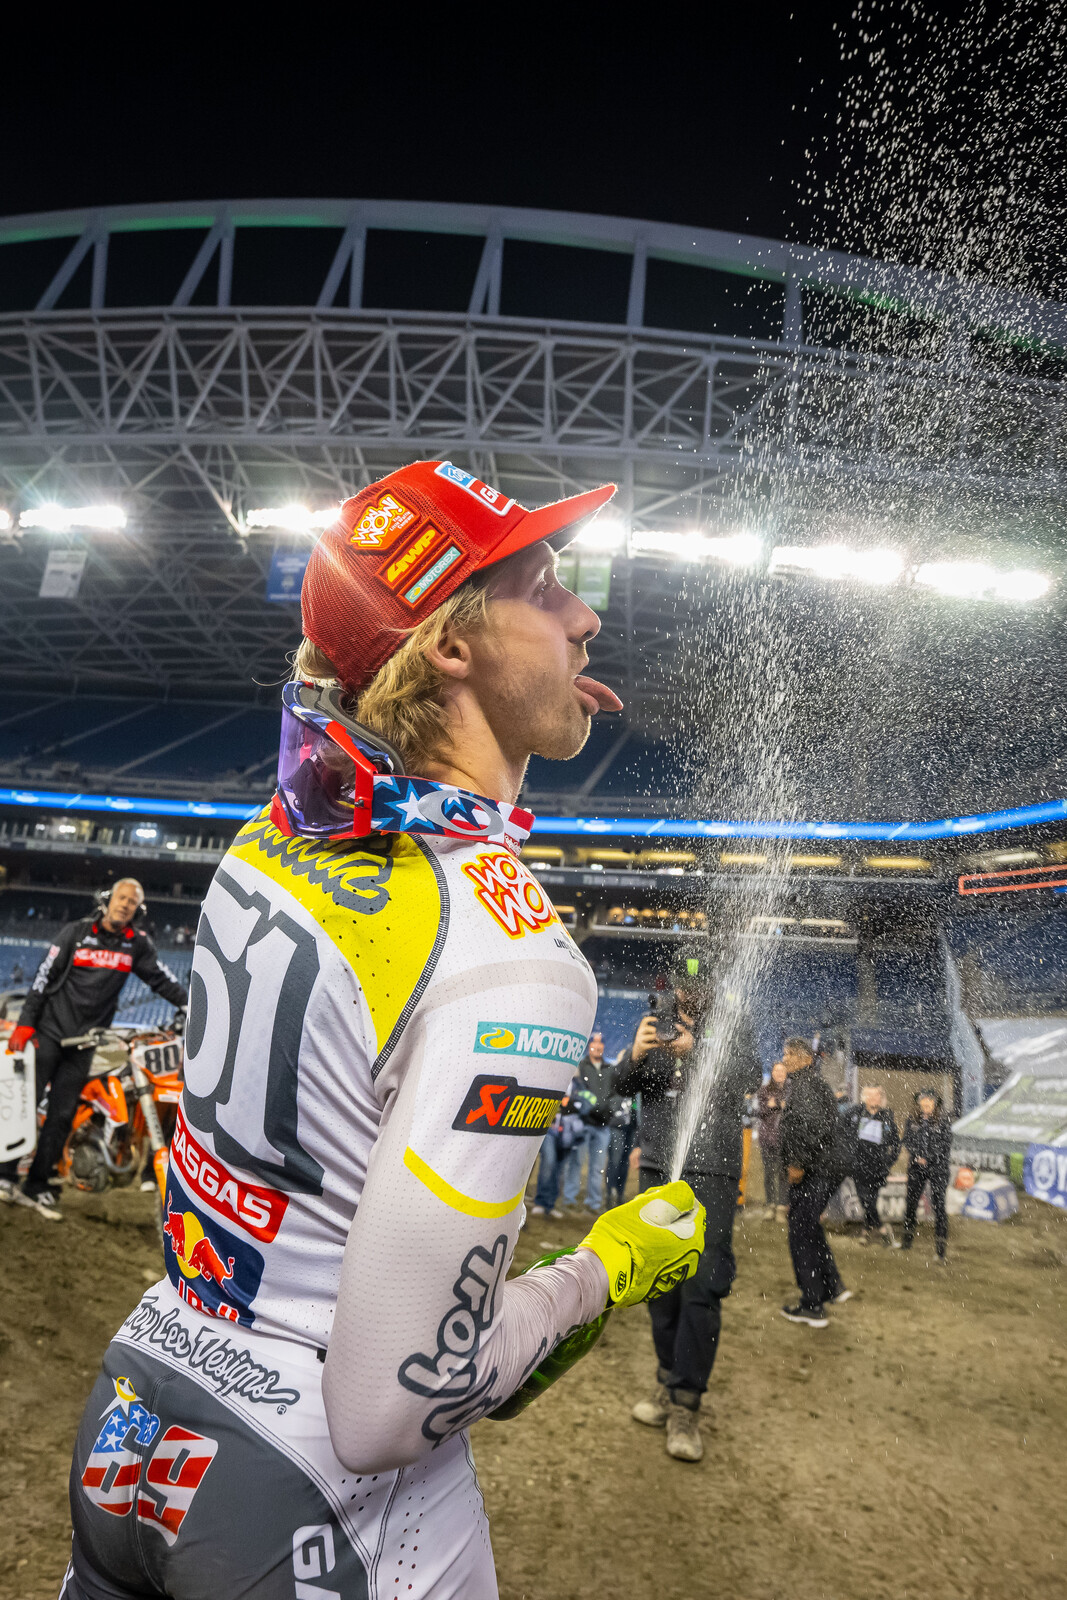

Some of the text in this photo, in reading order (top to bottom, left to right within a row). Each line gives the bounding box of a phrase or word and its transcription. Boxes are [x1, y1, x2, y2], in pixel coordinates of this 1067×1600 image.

[387, 529, 436, 583] 4WP
[418, 549, 458, 590] MOTOREX
[479, 885, 556, 934] WO
[144, 1044, 179, 1074] 80
[516, 1027, 587, 1062] MOTORE
[173, 1114, 272, 1229] GASGAS
[149, 1307, 192, 1359] Lee
